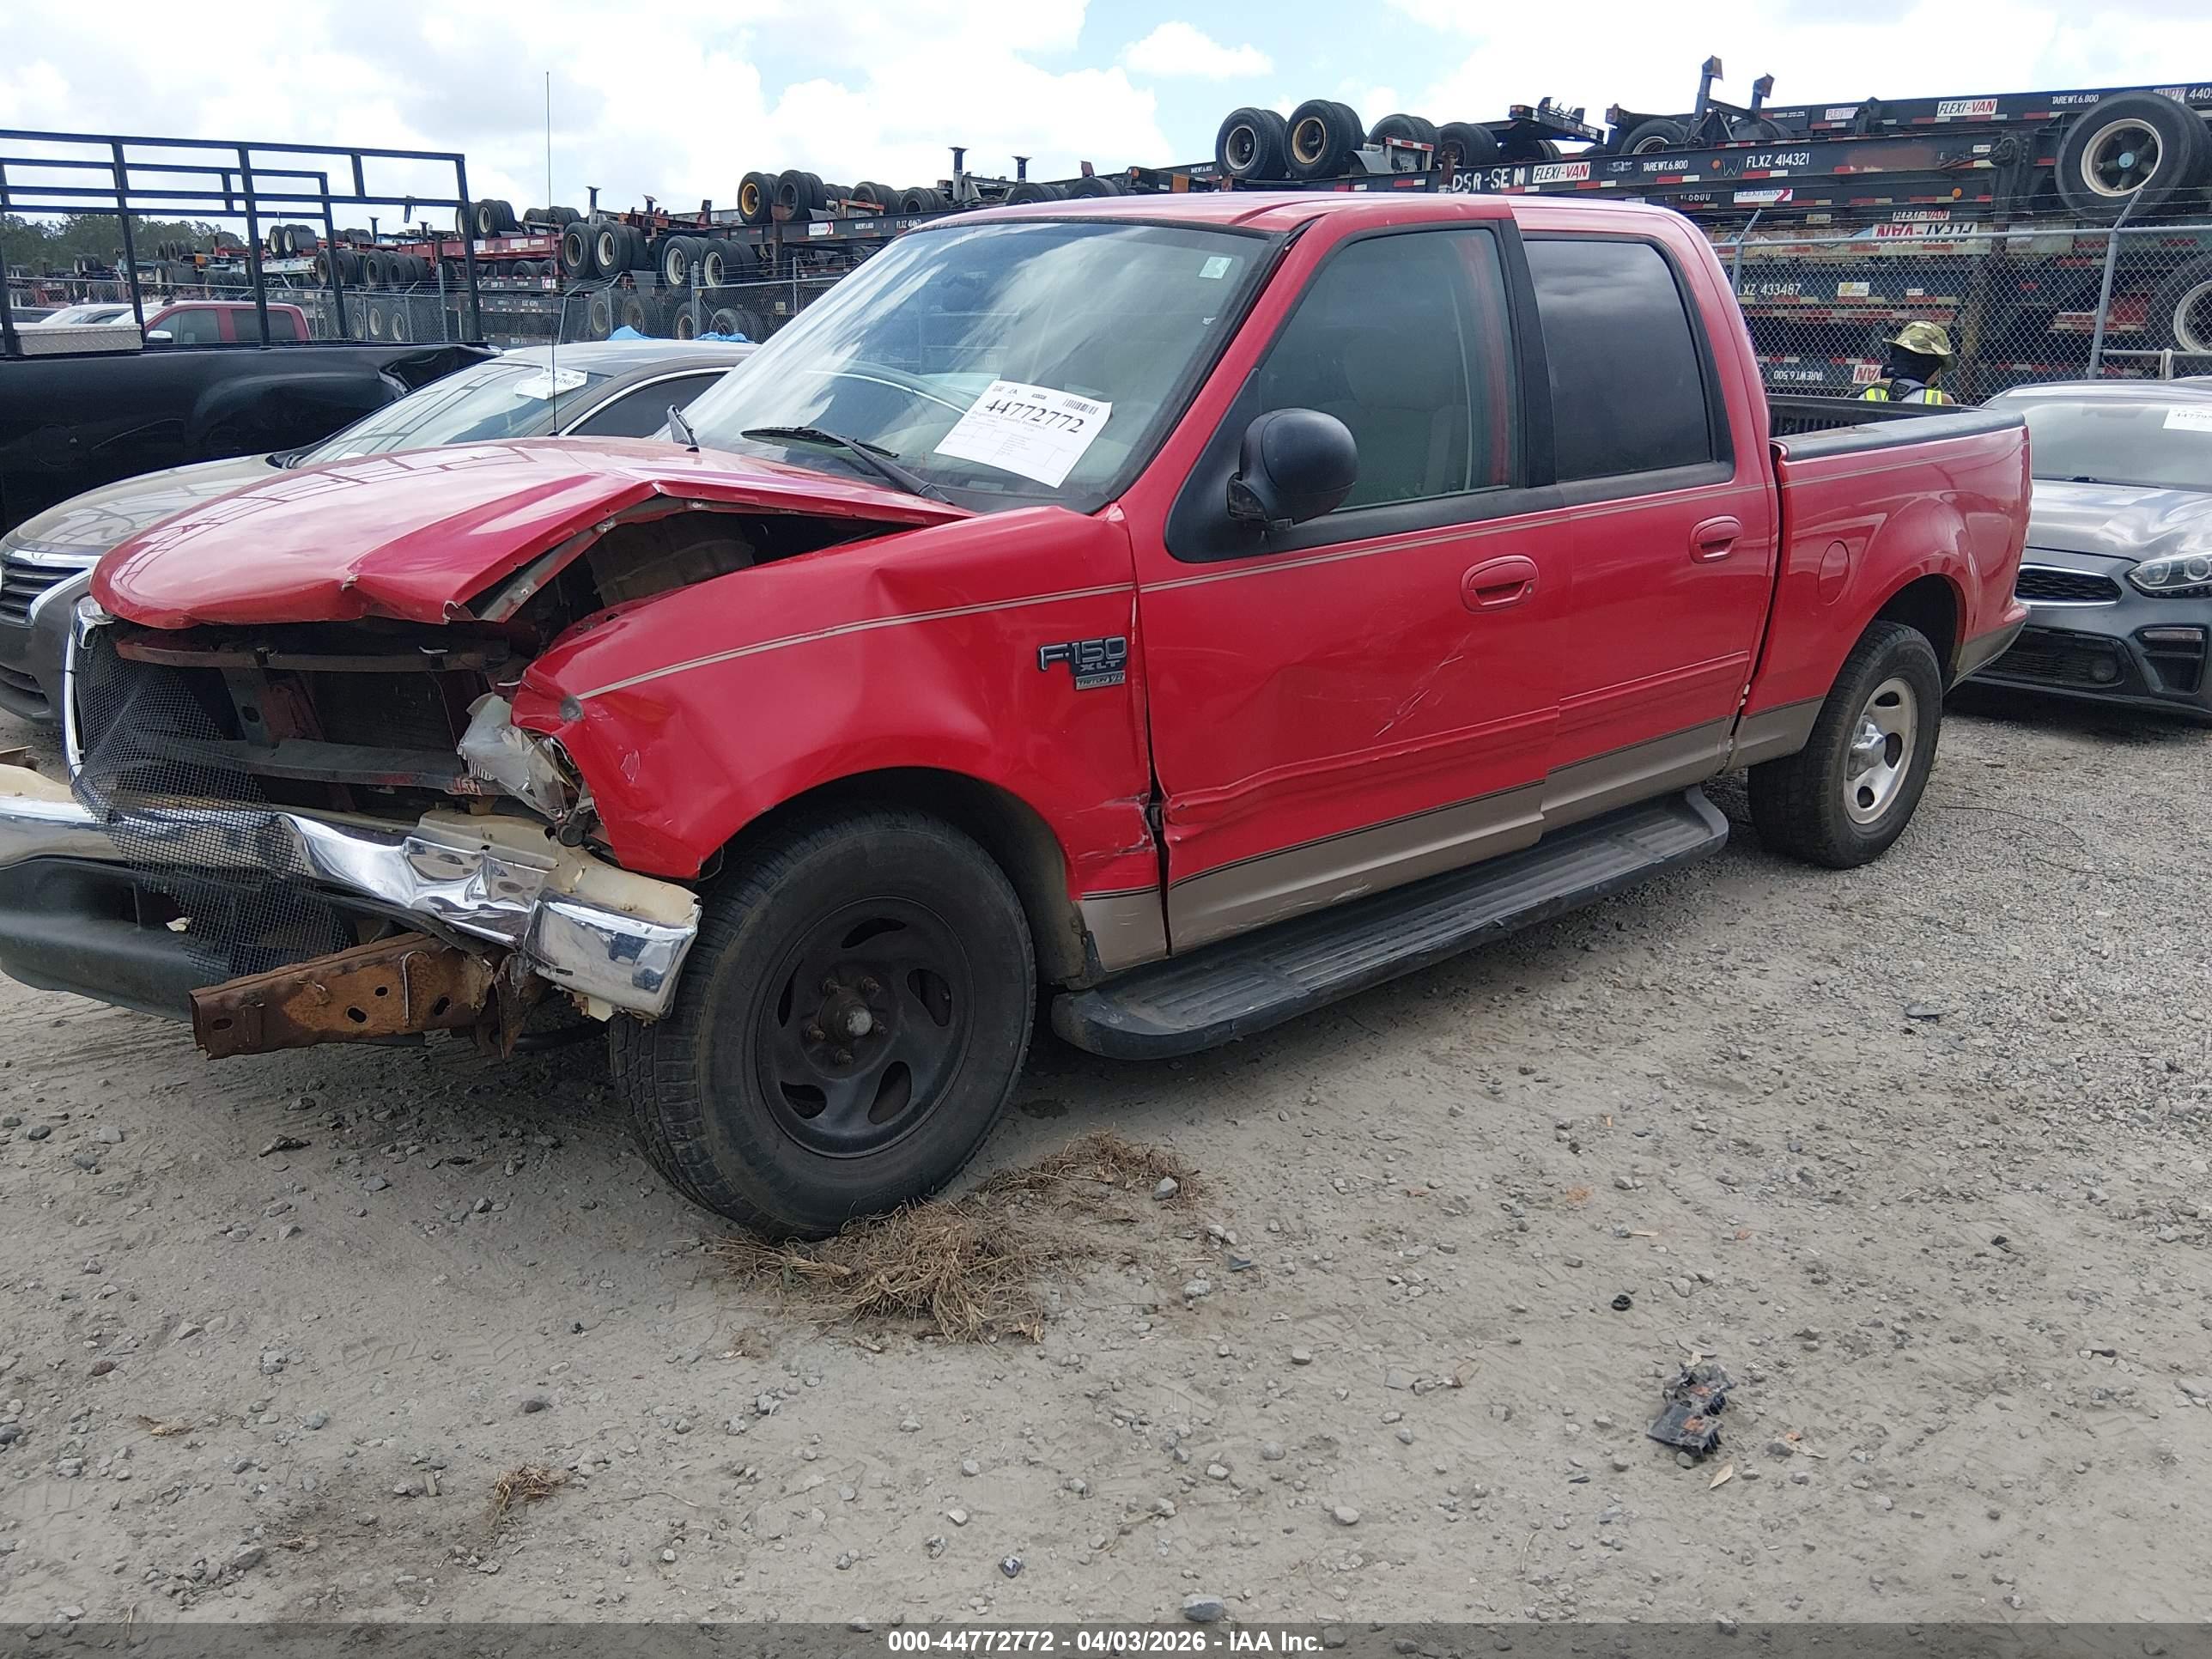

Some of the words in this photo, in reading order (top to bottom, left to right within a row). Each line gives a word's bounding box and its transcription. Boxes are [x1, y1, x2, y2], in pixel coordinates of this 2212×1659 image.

[2188, 88, 2212, 100] 440
[1938, 100, 1995, 114] FLEXI-VAN
[1746, 155, 1772, 168] FLXZ
[1775, 153, 1810, 167] 414321
[1534, 164, 1589, 180] FLEXI-VAN
[1760, 283, 1802, 295] 433487
[985, 399, 1085, 434] 44772772
[1079, 659, 1121, 672] XLT
